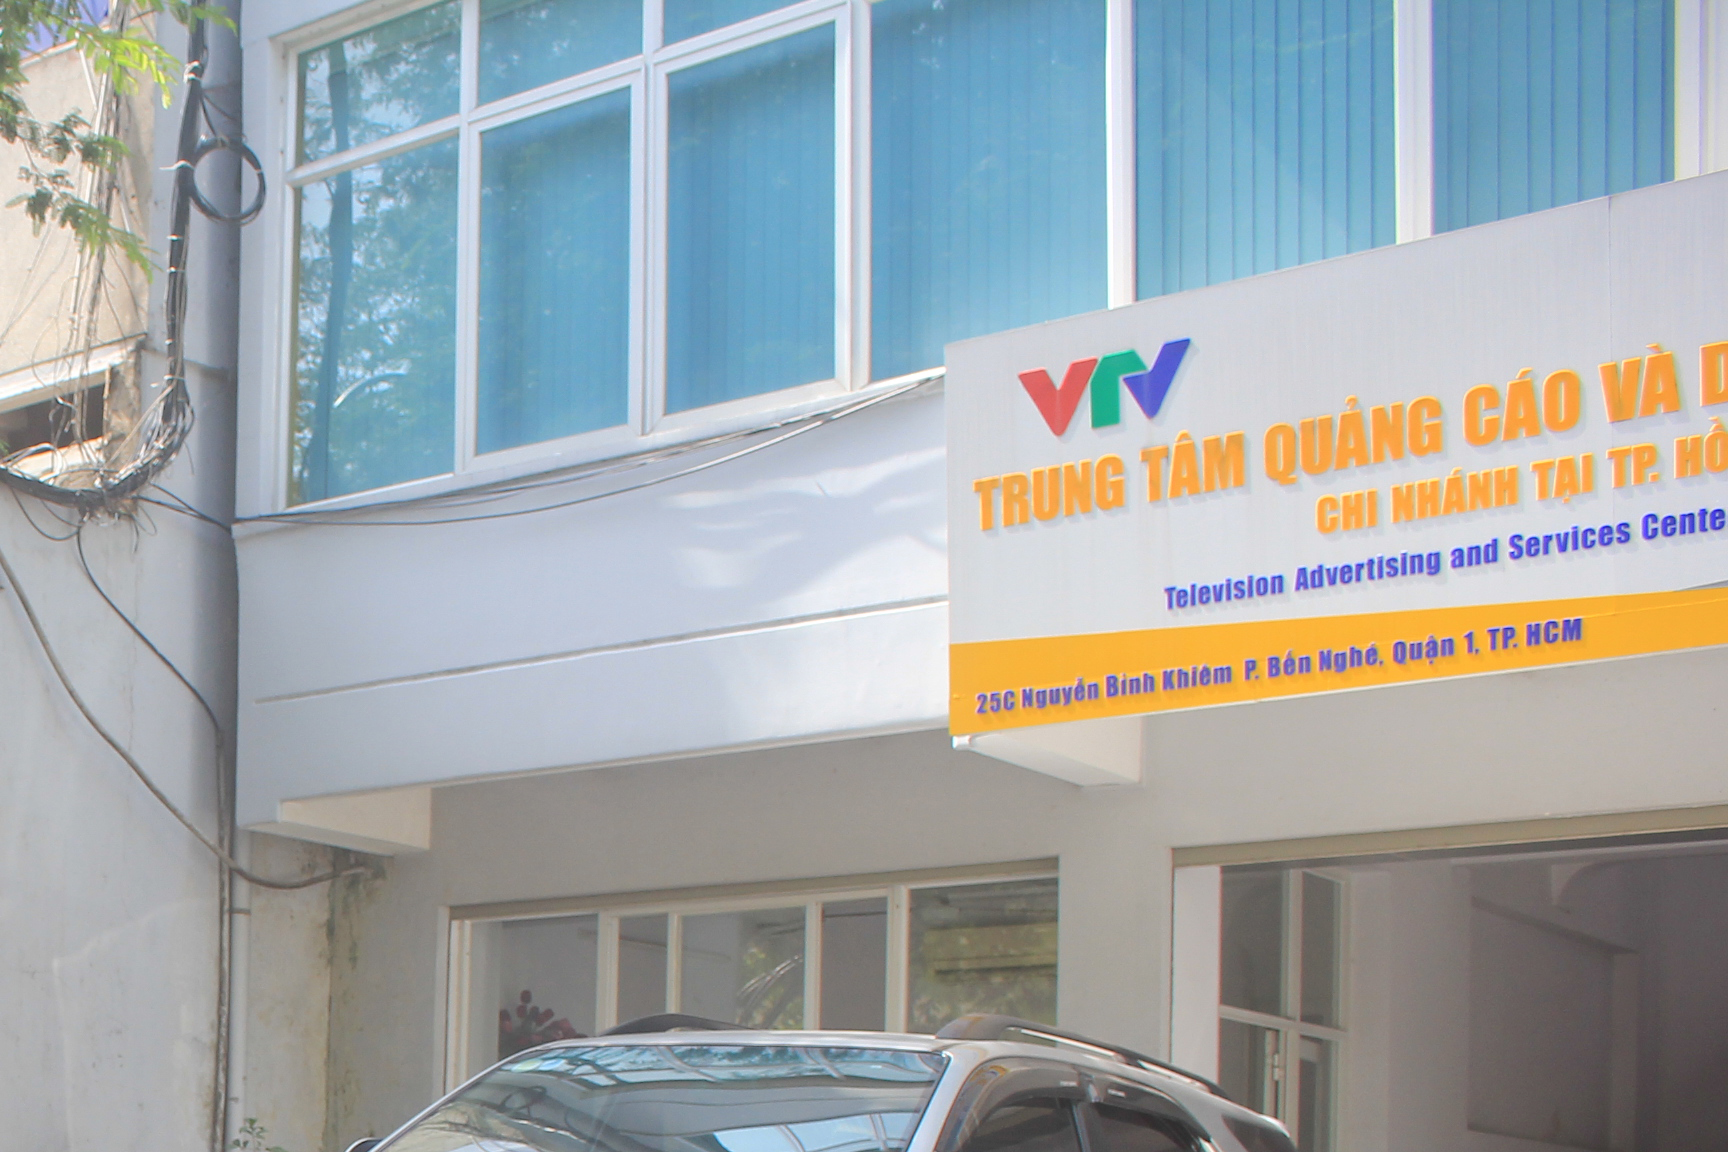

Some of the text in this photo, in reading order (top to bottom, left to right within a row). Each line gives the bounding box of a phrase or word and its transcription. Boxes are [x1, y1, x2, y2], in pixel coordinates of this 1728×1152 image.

[973, 453, 1126, 531] TRUNG
[1139, 430, 1245, 503] TÂM
[1263, 394, 1443, 485] QUẢNG
[1462, 367, 1581, 446] CÁO
[1598, 343, 1681, 423] VÀ
[1017, 337, 1192, 437] VTV
[1315, 416, 1728, 534] CHI NHÁNH TẠI TP. HỒ
[1164, 573, 1284, 610] Television
[1294, 550, 1441, 592] Advertising
[1450, 538, 1499, 569] and
[1508, 521, 1631, 560] Services
[976, 689, 1016, 714] 25C
[1244, 658, 1259, 681] P.
[1267, 649, 1311, 678] Bến
[1392, 634, 1455, 666] Quận
[1464, 630, 1479, 656] 1,
[1486, 626, 1518, 651] TP.
[1526, 617, 1583, 646] HCM
